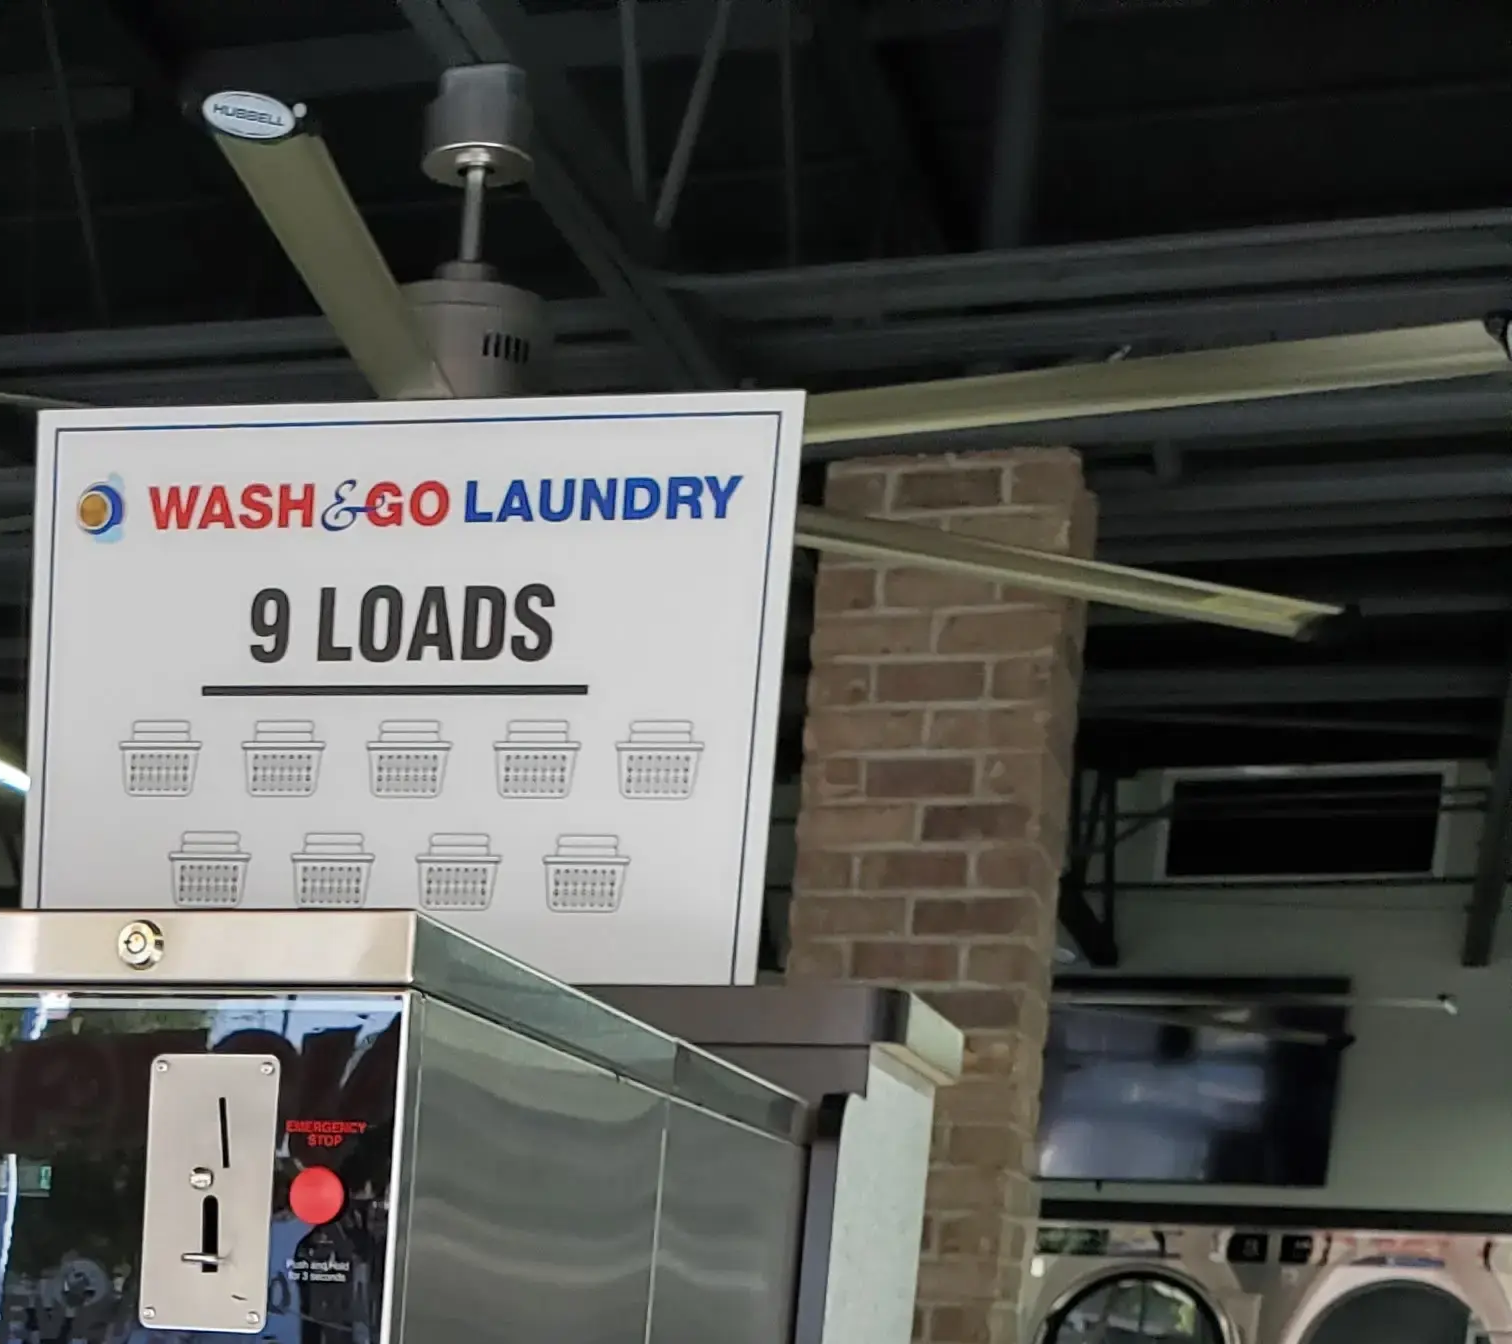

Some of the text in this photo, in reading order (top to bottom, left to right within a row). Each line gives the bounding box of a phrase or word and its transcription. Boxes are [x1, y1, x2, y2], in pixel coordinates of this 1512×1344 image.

[463, 475, 744, 524] LAUNDRY
[250, 583, 556, 663] 9 LOADS
[285, 1120, 367, 1134] EMERGENCY
[307, 1133, 343, 1147] STOP
